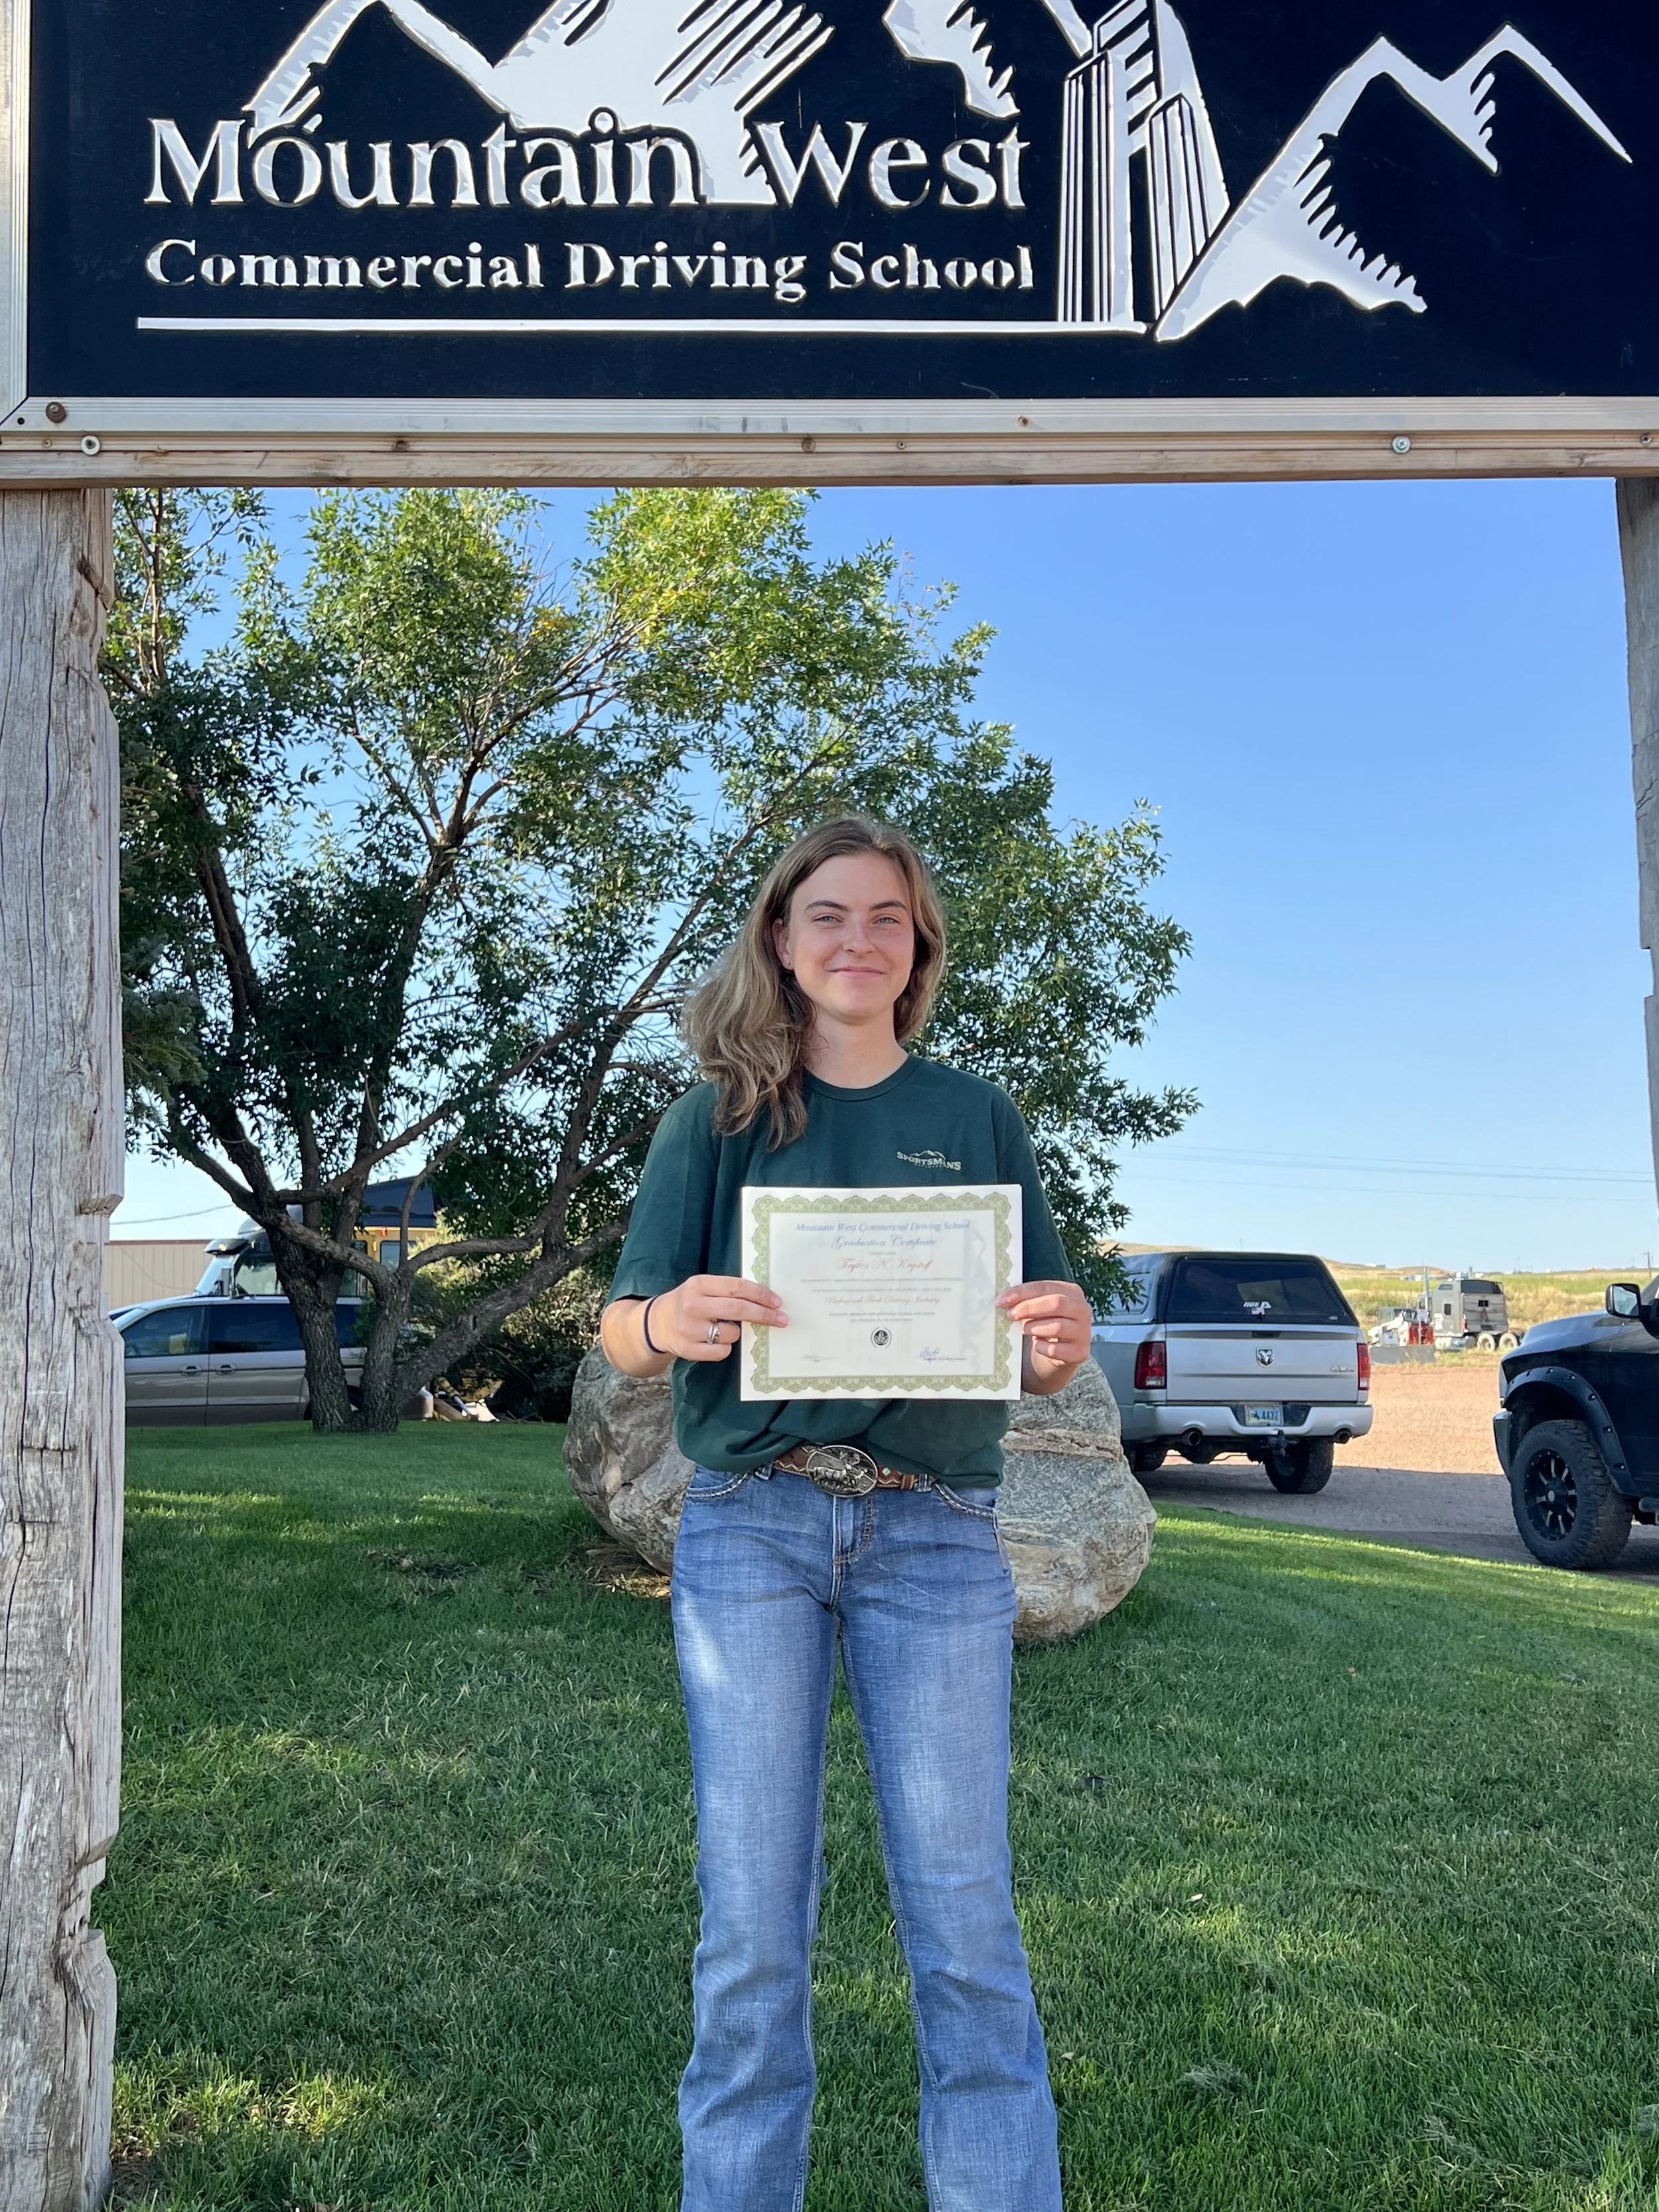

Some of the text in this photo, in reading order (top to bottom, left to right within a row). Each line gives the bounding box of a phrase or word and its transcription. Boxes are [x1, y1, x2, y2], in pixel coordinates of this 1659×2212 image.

[143, 107, 1031, 210] Mountain West
[145, 238, 1035, 303] Commercial Driving School
